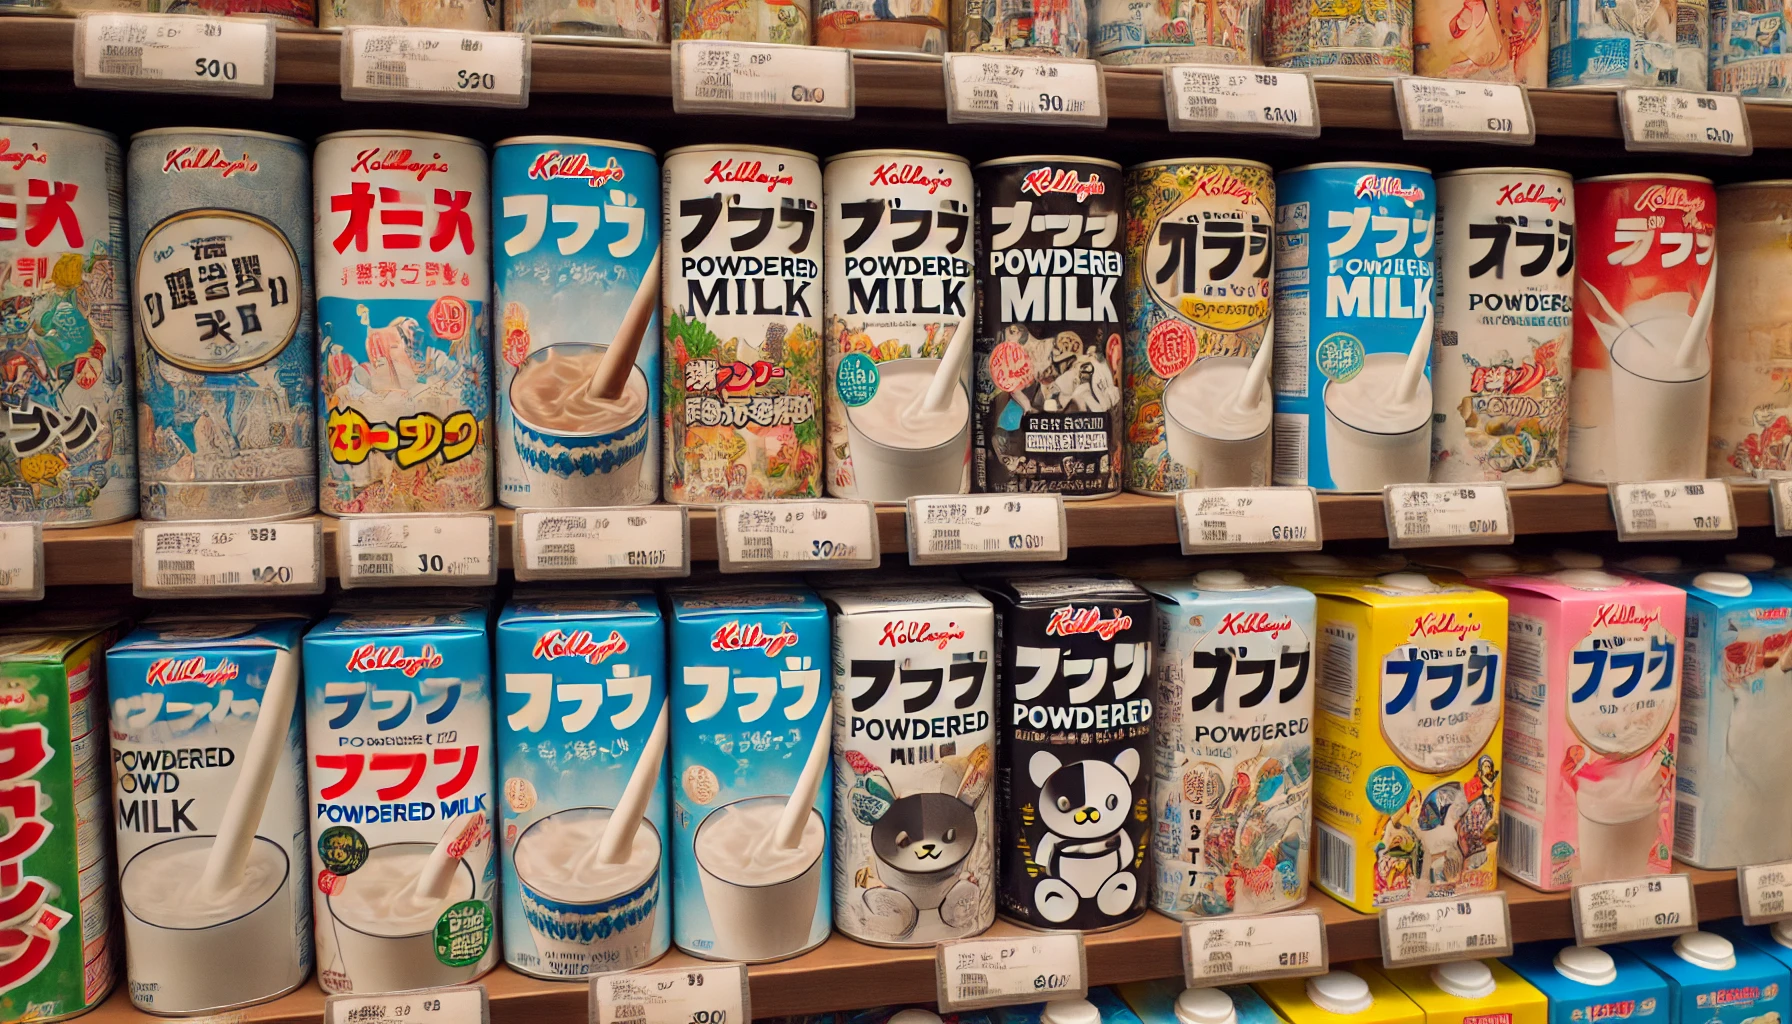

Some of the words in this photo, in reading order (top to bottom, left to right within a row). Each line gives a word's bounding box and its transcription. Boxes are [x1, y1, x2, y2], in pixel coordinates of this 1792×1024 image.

[682, 256, 818, 279] POWDERED
[687, 278, 813, 318] MILK
[847, 277, 966, 318] MILK
[1000, 276, 1119, 323] MILK
[1326, 275, 1434, 319] MILK
[852, 710, 990, 741] POWDERED
[112, 747, 235, 772] POWDERED
[119, 798, 198, 833] MILK
[317, 801, 436, 824] POWDERED
[440, 793, 487, 820] MILK
